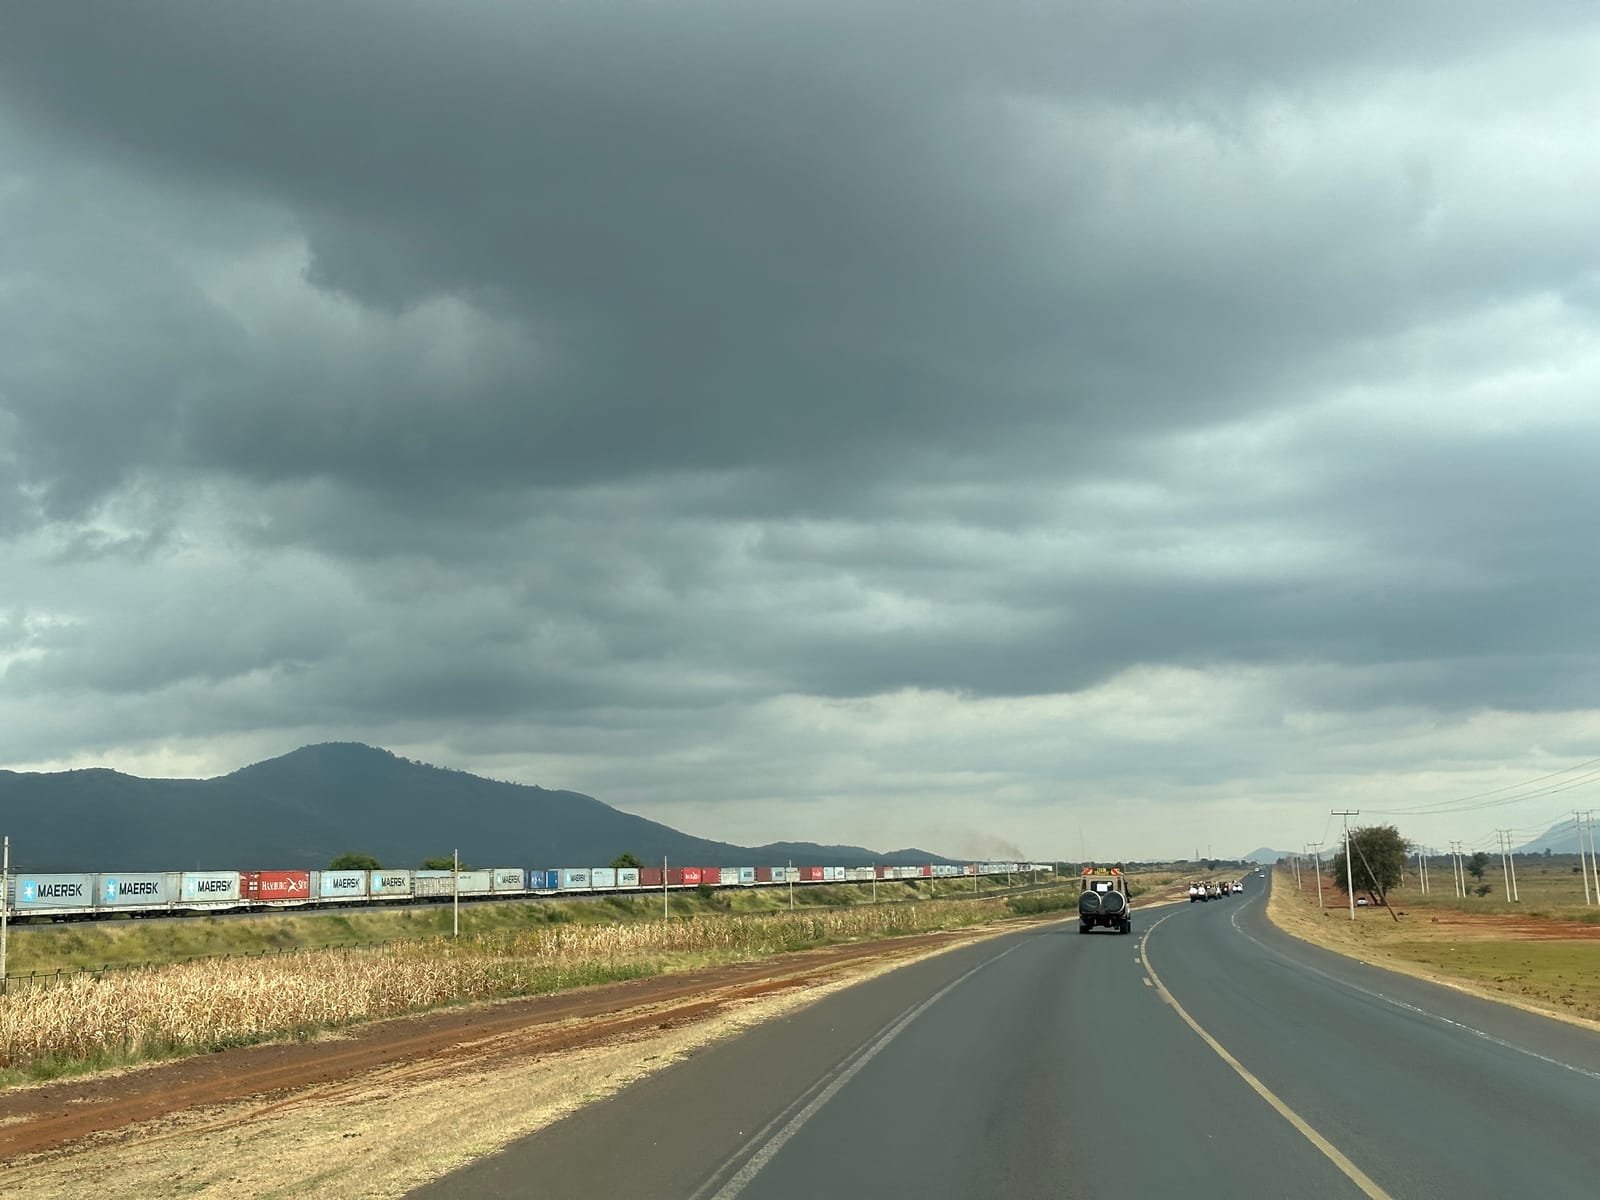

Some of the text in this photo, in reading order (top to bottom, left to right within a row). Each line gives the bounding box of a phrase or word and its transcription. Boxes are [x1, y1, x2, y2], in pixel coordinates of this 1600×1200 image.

[198, 880, 232, 892] MAERSK
[333, 878, 360, 888] MAERSK
[381, 877, 405, 887] MAERSK
[37, 884, 82, 897] MAERSK
[119, 882, 158, 895] MAERSK
